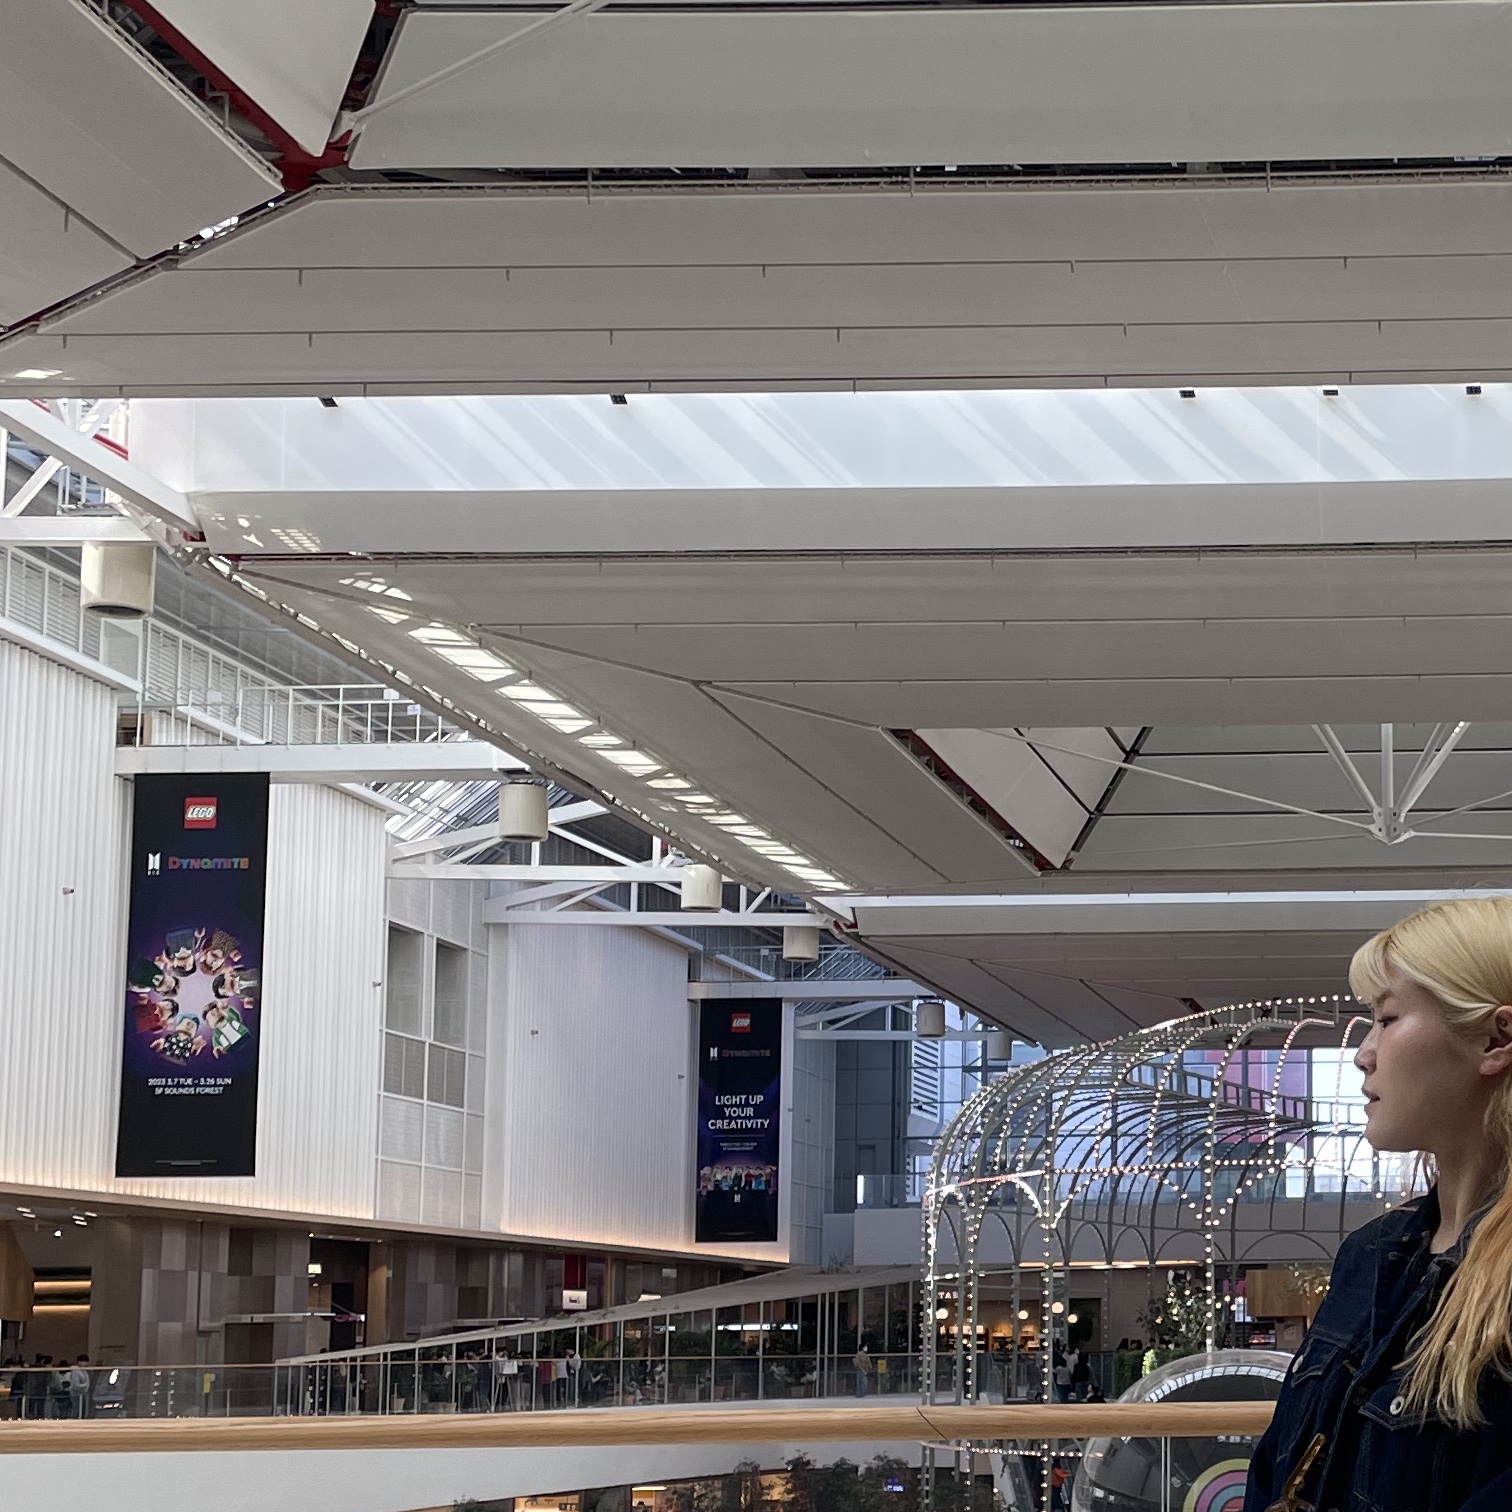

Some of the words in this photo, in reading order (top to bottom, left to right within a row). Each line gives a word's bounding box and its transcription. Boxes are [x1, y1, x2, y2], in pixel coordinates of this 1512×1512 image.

[186, 806, 216, 820] LEGO
[715, 1095, 747, 1105] LIGHT
[749, 1095, 763, 1105] UP
[724, 1107, 754, 1117] YOUR
[708, 1119, 770, 1129] CREATIVITY
